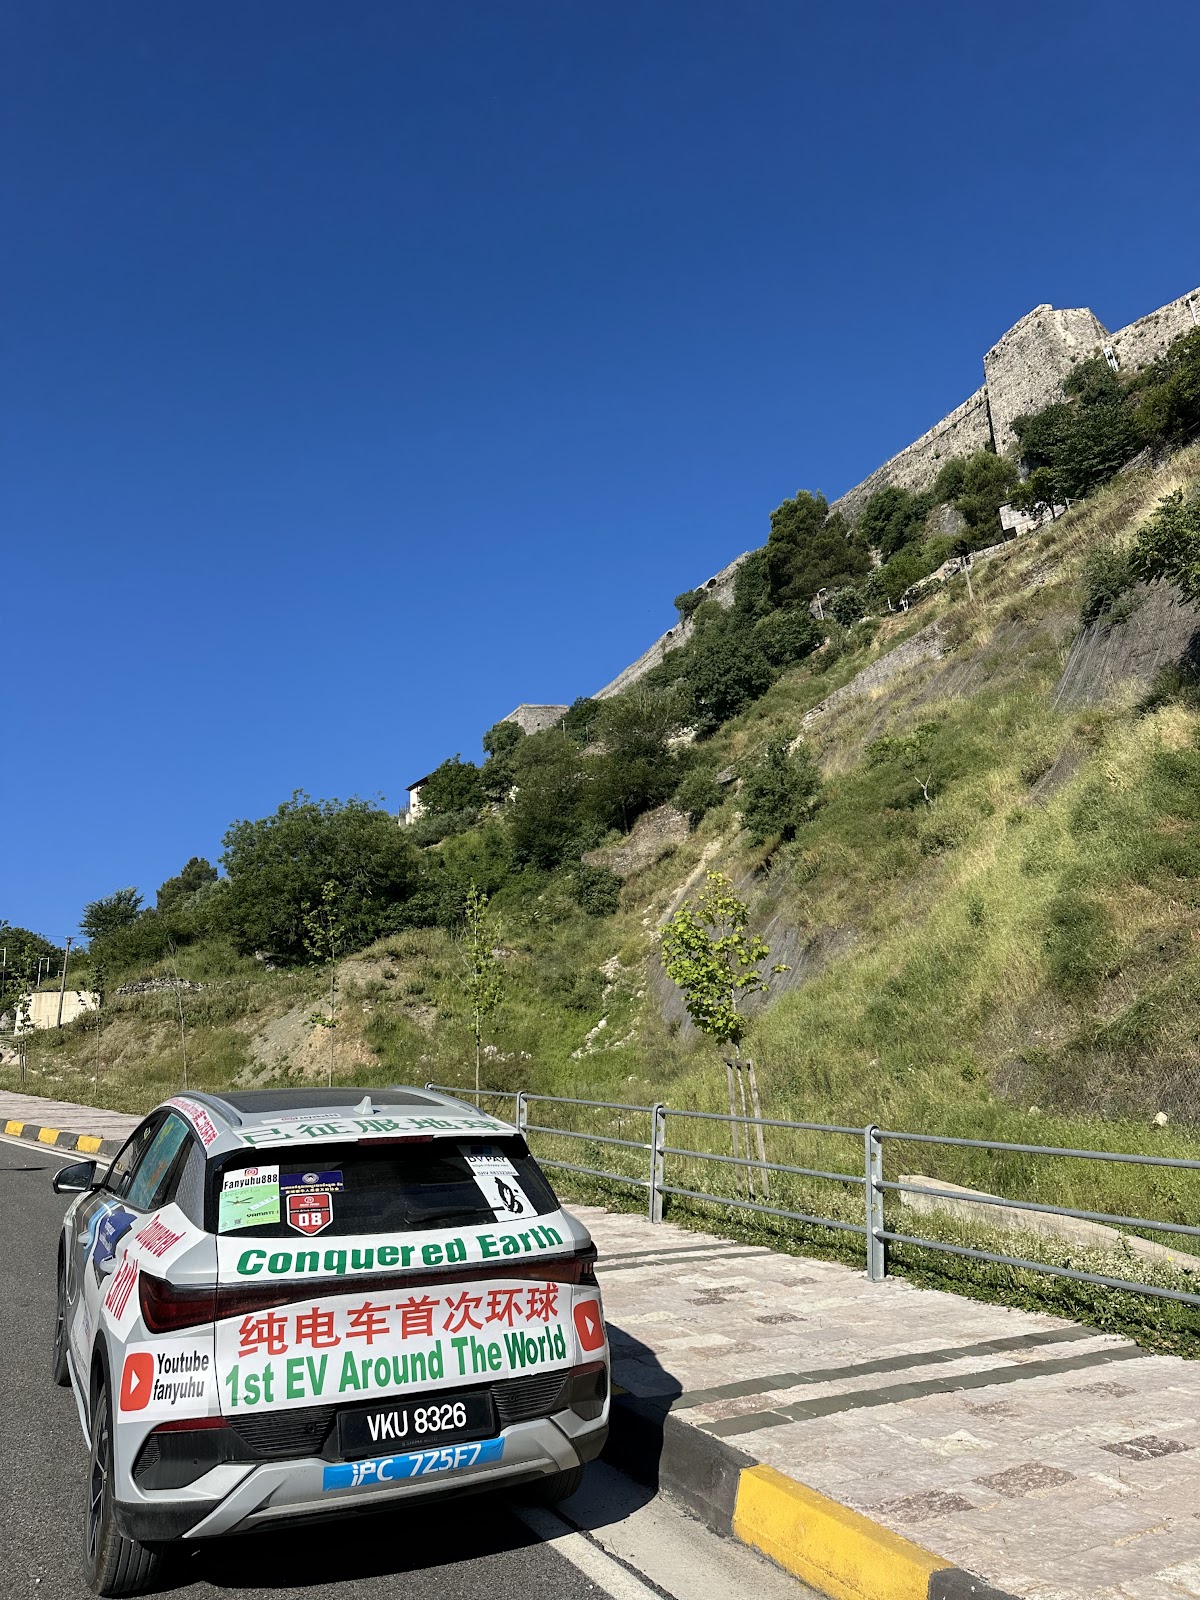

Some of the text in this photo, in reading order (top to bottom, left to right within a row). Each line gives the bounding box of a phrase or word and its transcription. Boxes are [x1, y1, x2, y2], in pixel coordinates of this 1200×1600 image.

[242, 1117, 511, 1145] 已征服地球
[224, 1174, 278, 1190] Fanyuhu888
[135, 1213, 186, 1259] Conquered
[298, 1212, 322, 1227] 08
[236, 1224, 564, 1276] Conquered Earth
[238, 1282, 560, 1359] 纯电车首次环球
[156, 1352, 210, 1376] Youtube
[224, 1324, 567, 1407] 1st EV Around The World
[152, 1377, 206, 1409] fanyuhu
[366, 1402, 467, 1441] VKU 8326
[351, 1444, 482, 1487] 沪C 7Z5F7
